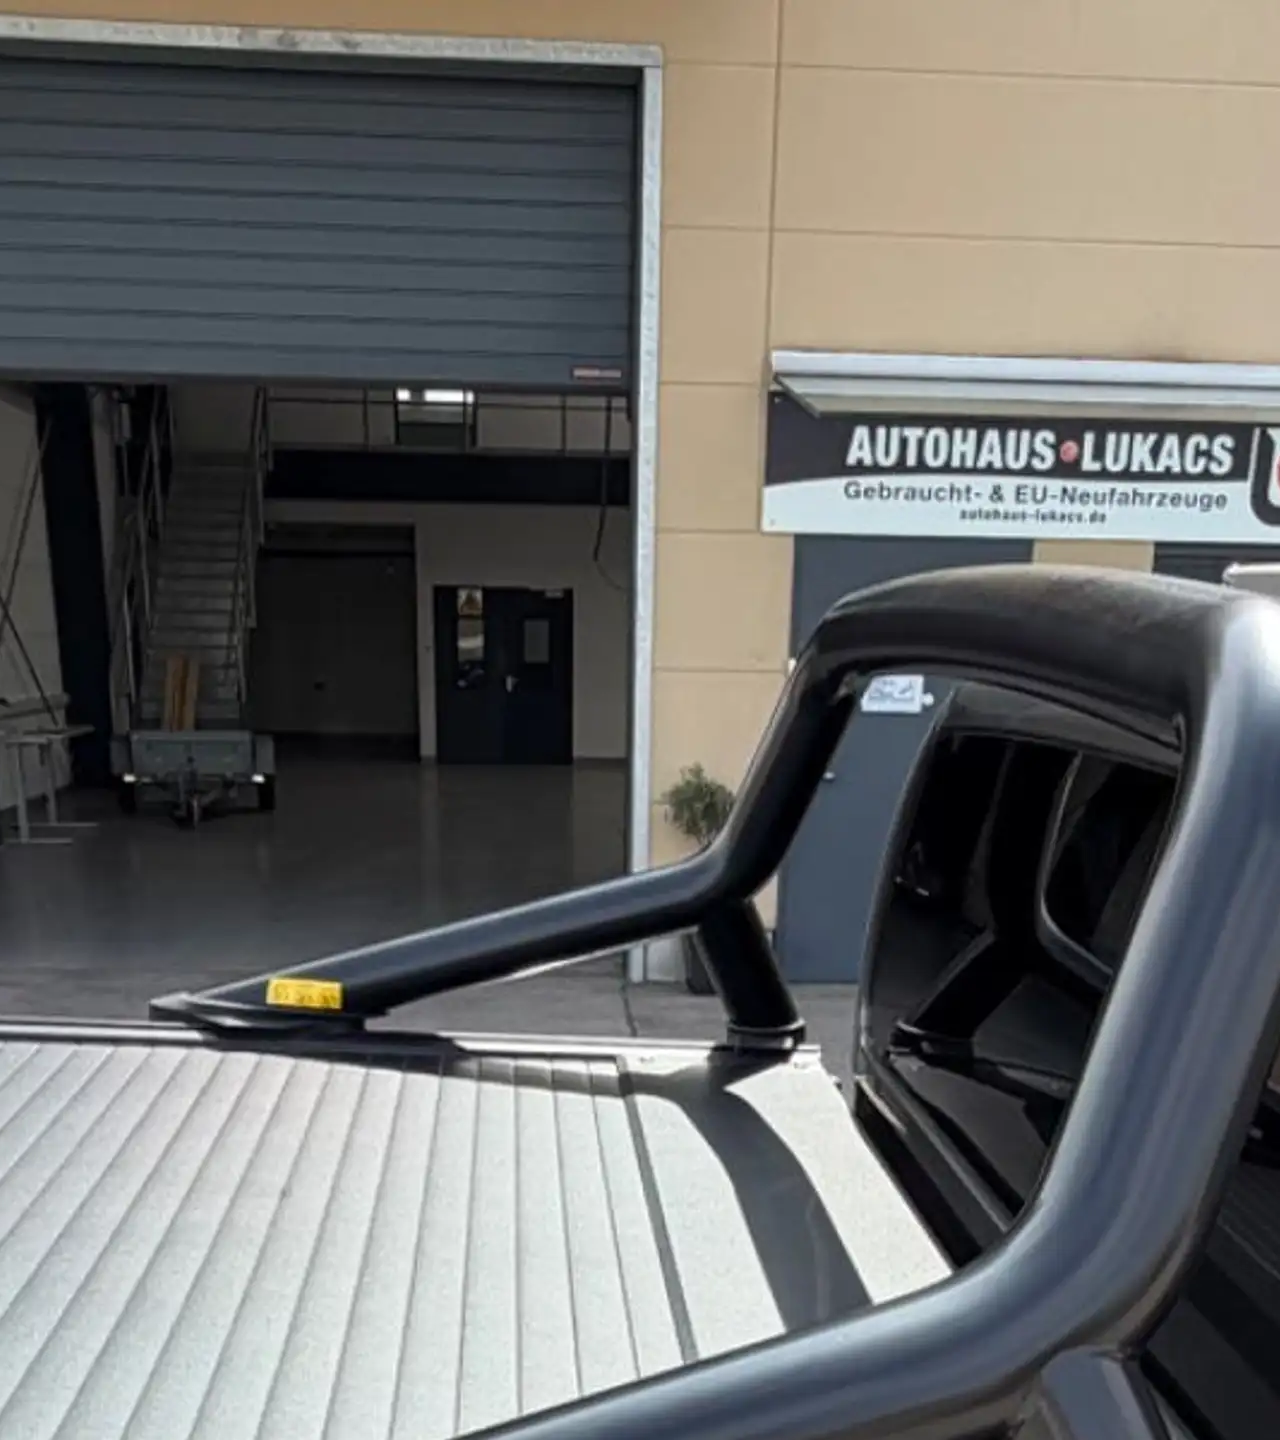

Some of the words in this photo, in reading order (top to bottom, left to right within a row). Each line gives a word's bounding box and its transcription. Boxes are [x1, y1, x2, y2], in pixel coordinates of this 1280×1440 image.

[845, 424, 1057, 471] AUTOHAUS
[1081, 430, 1236, 475] LUKACS
[843, 480, 983, 504] Gebraucht-
[988, 484, 1005, 504] &
[1014, 484, 1229, 512] EU-Neufahrzeuge
[959, 508, 1107, 524] autohaus-lukacs.de
